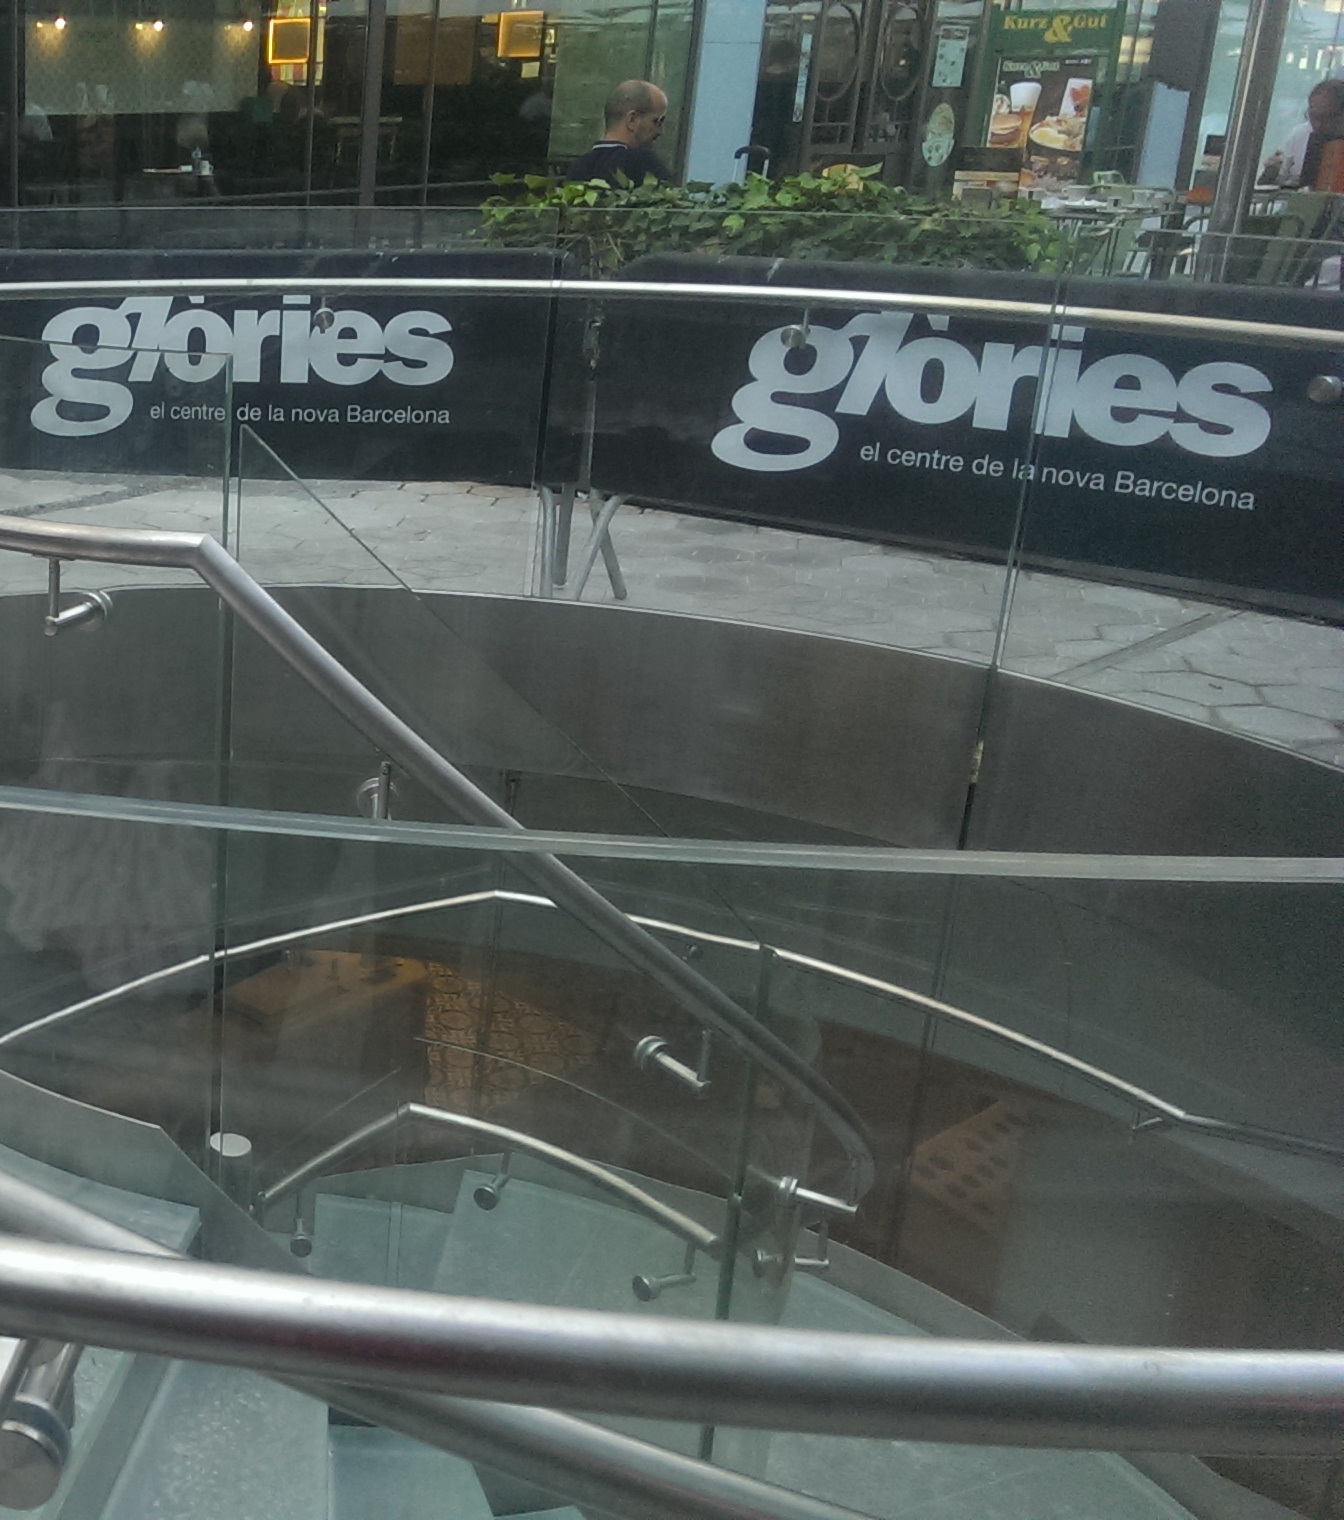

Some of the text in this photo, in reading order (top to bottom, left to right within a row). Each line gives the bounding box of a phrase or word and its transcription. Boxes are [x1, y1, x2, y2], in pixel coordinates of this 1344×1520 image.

[1004, 14, 1108, 43] Kurz & Gut
[150, 401, 450, 424] el centre de la nova Barcelona
[860, 442, 1256, 511] el centre de la nova Barcelona
